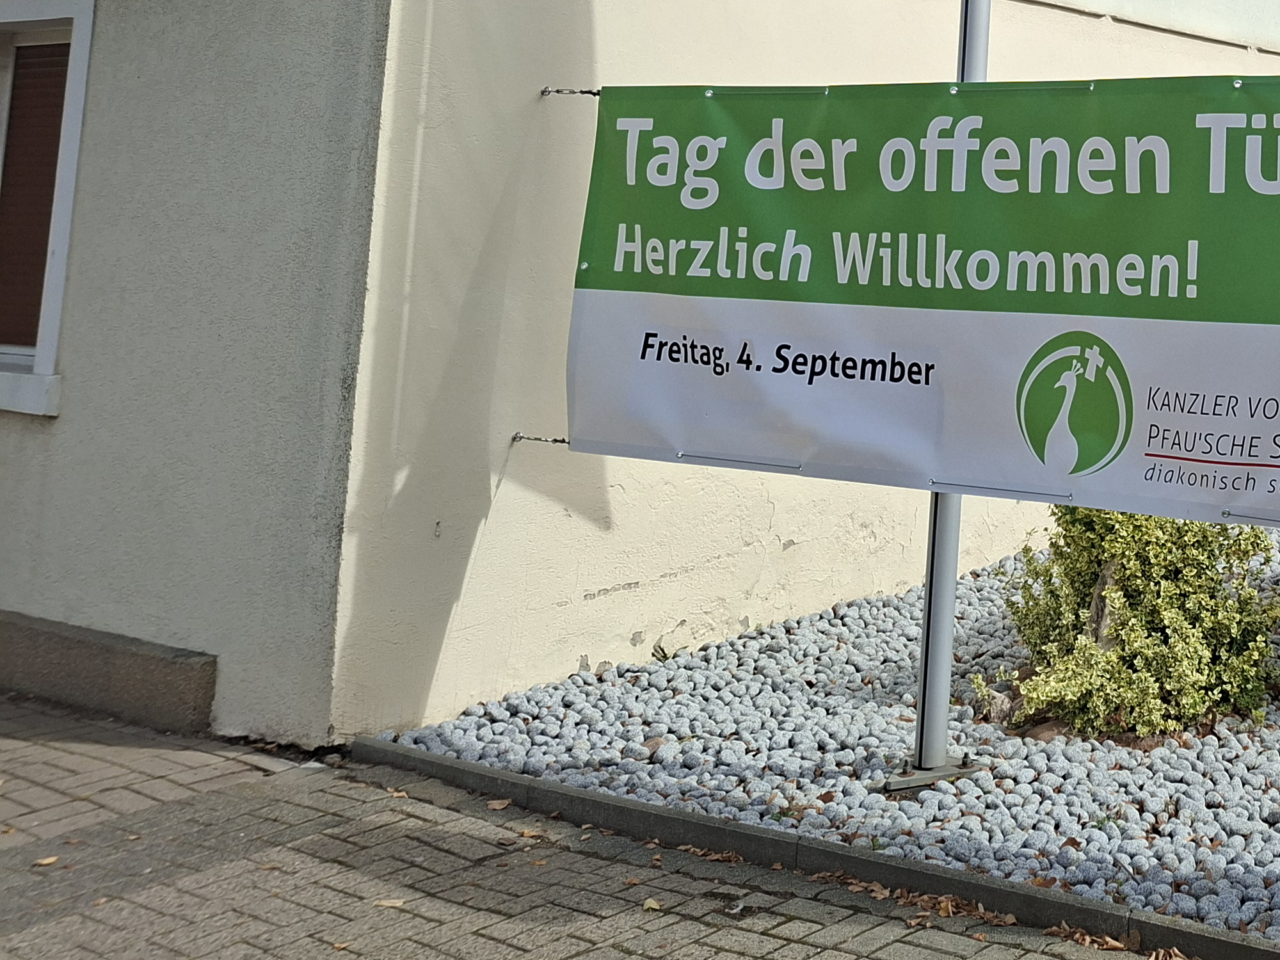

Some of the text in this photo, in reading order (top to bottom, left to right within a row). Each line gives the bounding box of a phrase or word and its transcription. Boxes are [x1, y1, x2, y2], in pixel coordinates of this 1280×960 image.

[615, 117, 727, 210] Tag
[744, 118, 858, 192] der
[879, 114, 1171, 195] offenen
[613, 223, 1200, 299] Herzlich Willkommen!
[640, 332, 936, 386] Freitag, 4. September
[1146, 387, 1239, 418] KANZLER
[1147, 423, 1262, 458] PFAU'SCHE
[1144, 463, 1257, 491] diakonisch
